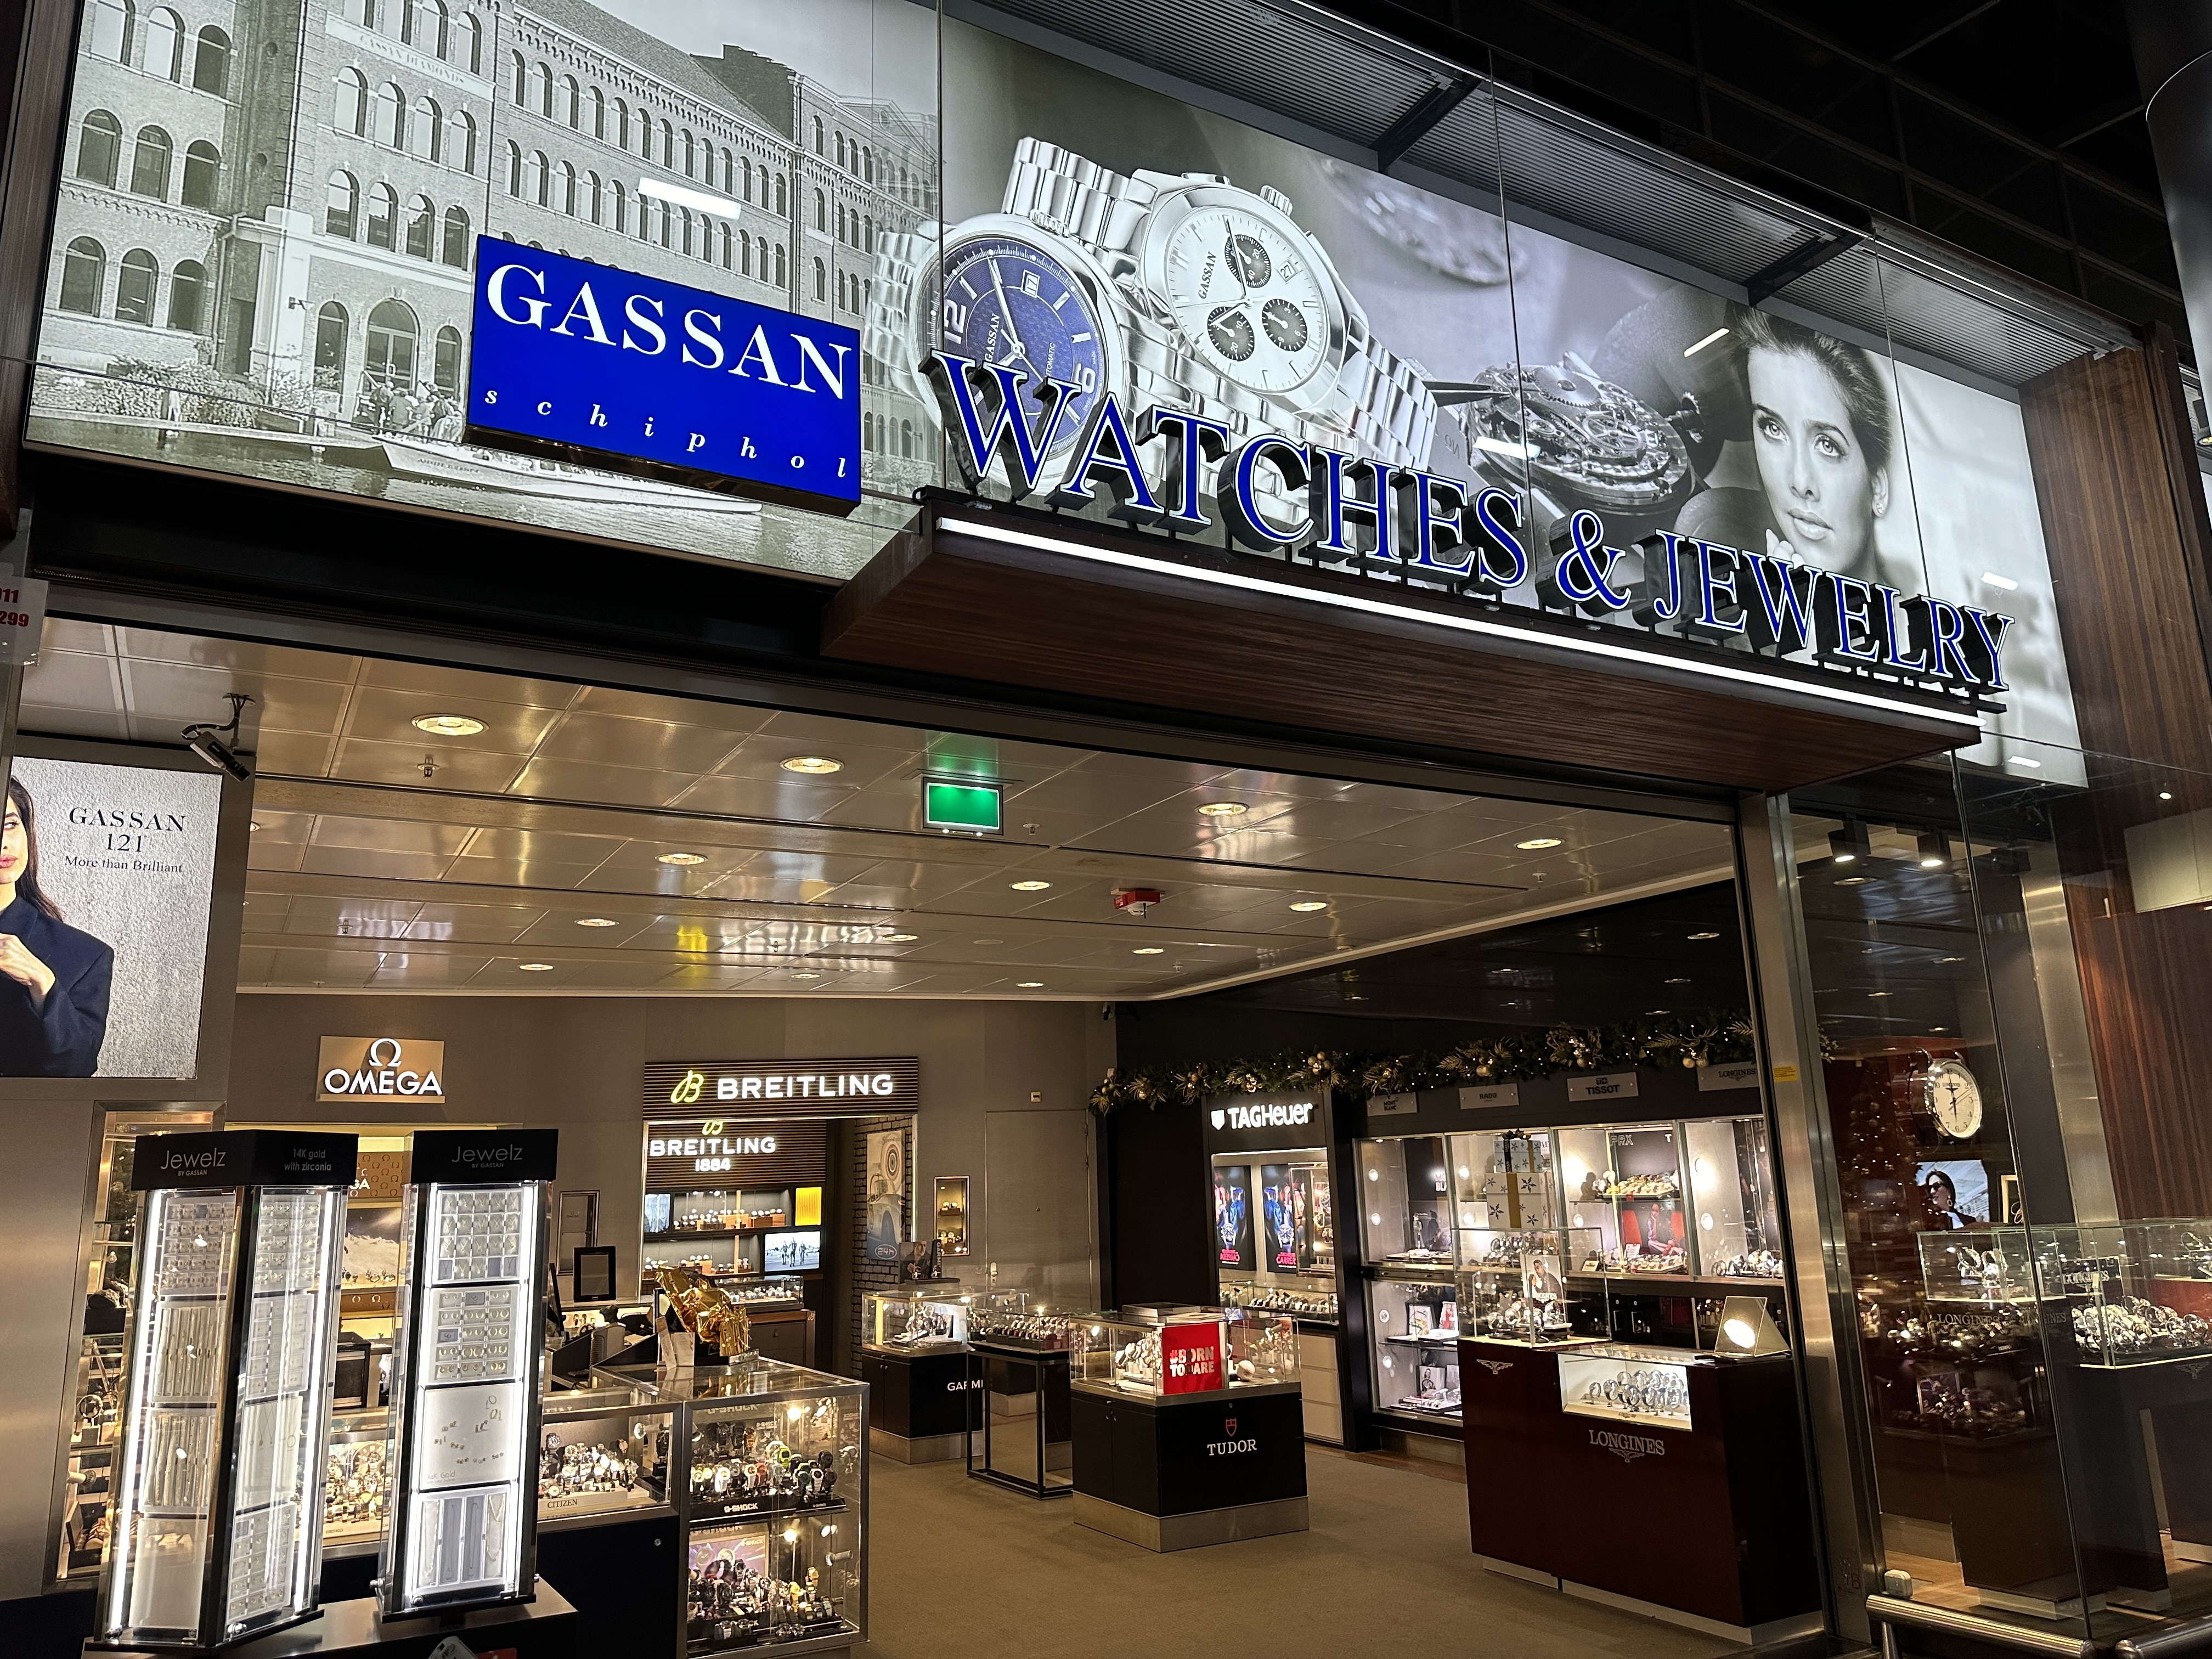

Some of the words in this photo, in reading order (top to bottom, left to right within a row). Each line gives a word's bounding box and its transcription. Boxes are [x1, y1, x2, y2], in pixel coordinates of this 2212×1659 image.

[1252, 248, 1260, 259] 20
[1198, 251, 1217, 300] GASSAN
[1248, 269, 1255, 280] 40
[1280, 264, 1293, 279] 27
[487, 264, 852, 399] GASSAN
[1235, 320, 1244, 330] 10
[985, 313, 1000, 362] GASSAN
[1230, 342, 1239, 353] 20
[484, 389, 847, 478] schiphol
[930, 348, 1529, 589] WATCHES
[1555, 509, 1631, 610] &
[1652, 528, 2016, 691] JEWELRY
[0, 588, 19, 603] 11
[69, 806, 187, 832] GASSAN
[106, 833, 142, 852] 121
[65, 856, 98, 867] More
[102, 859, 128, 870] than
[133, 860, 183, 873] Brilliant
[1718, 1068, 1756, 1078] LONGINES
[325, 1069, 443, 1095] OMEGA
[716, 1074, 894, 1100] BREITLING
[1585, 1084, 1620, 1096] TISSOT
[649, 1137, 777, 1157] BREITLING
[1610, 1134, 1634, 1147] PRX
[160, 1147, 227, 1171] Jewelz
[292, 1149, 307, 1159] 14K
[308, 1149, 326, 1160] gold
[452, 1144, 523, 1163] Jewelz
[284, 1161, 300, 1171] with
[302, 1161, 332, 1171] zirconia
[695, 1158, 731, 1172] 1884
[1207, 1438, 1257, 1456] TUDOR
[1588, 1429, 1665, 1456] LONGINES
[441, 1470, 455, 1479] Gold
[547, 1498, 578, 1509] CITIZEN
[724, 1502, 758, 1513] G-SHOCK
